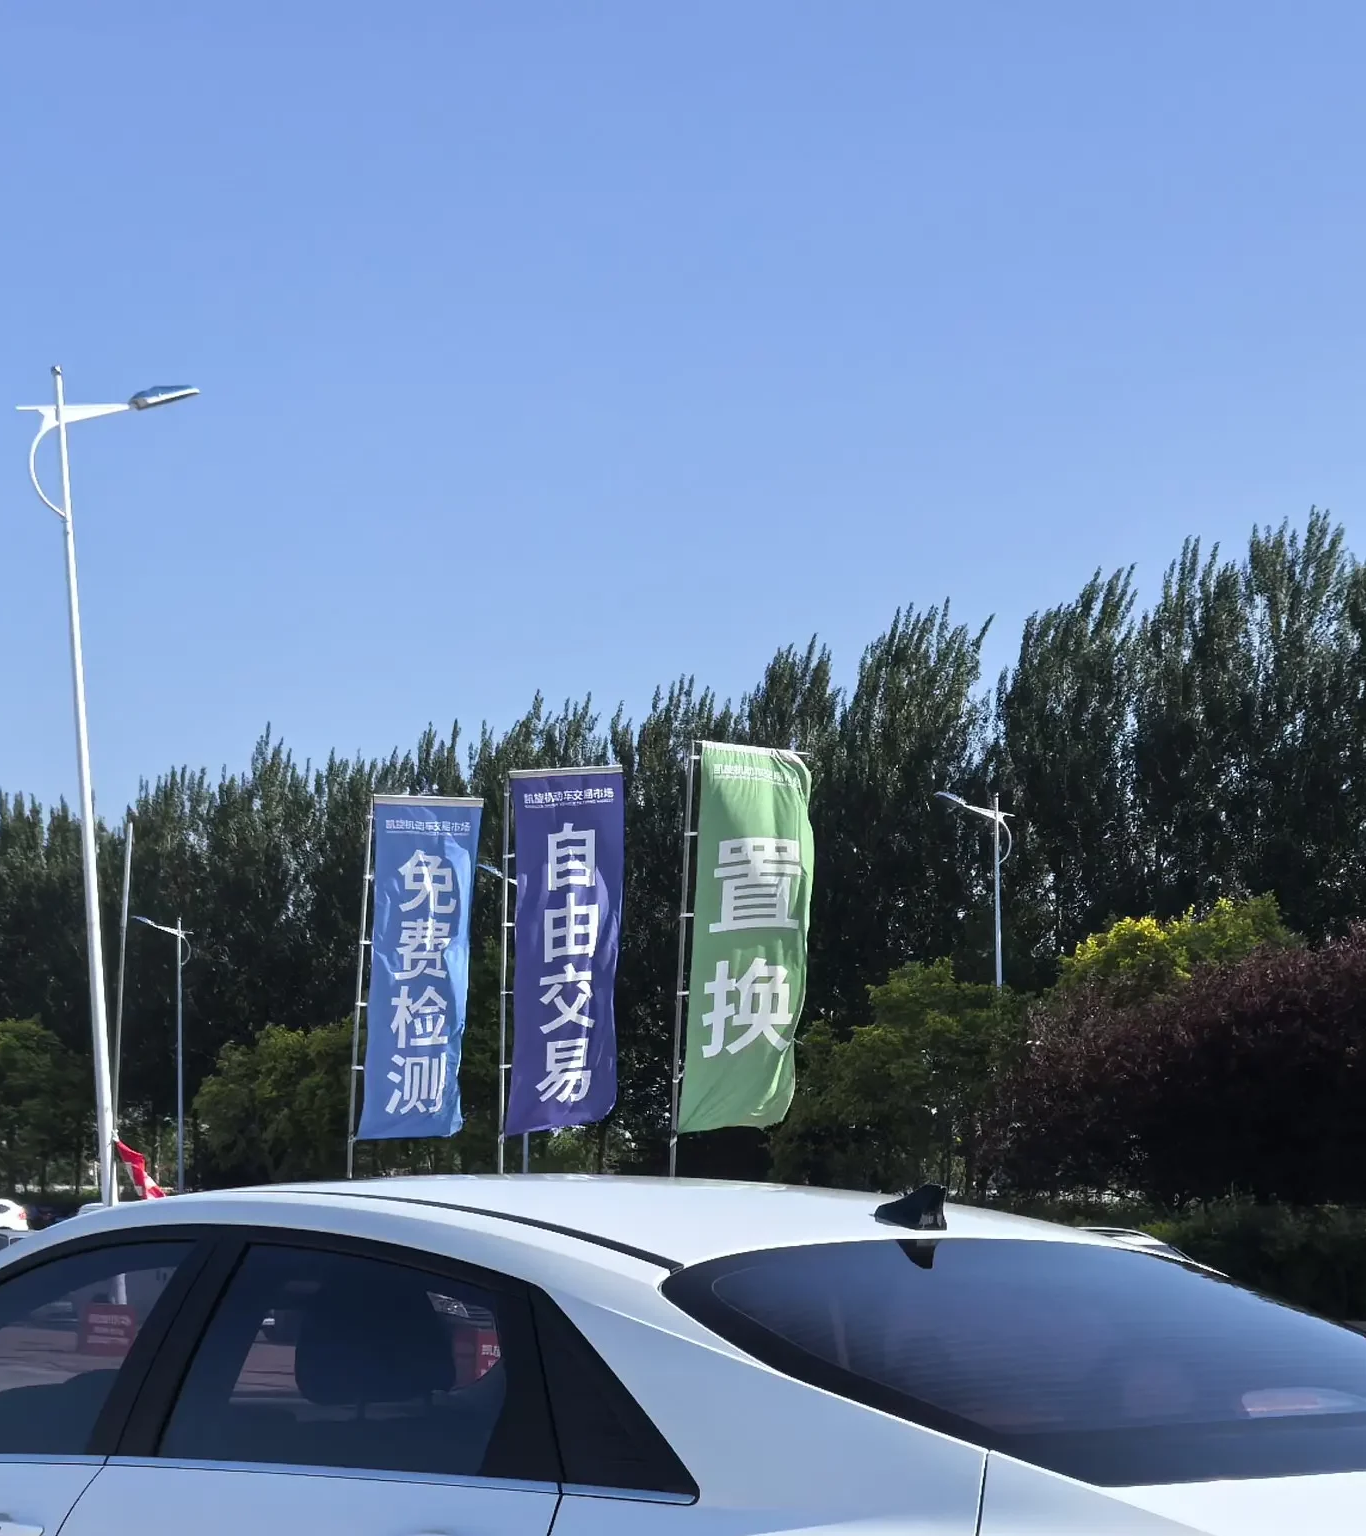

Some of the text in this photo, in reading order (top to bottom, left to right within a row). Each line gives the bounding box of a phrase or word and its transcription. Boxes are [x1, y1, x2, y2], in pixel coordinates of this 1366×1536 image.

[385, 849, 457, 1115] 免费检测
[535, 822, 601, 1103] 自由交易
[701, 837, 802, 1058] 置换
